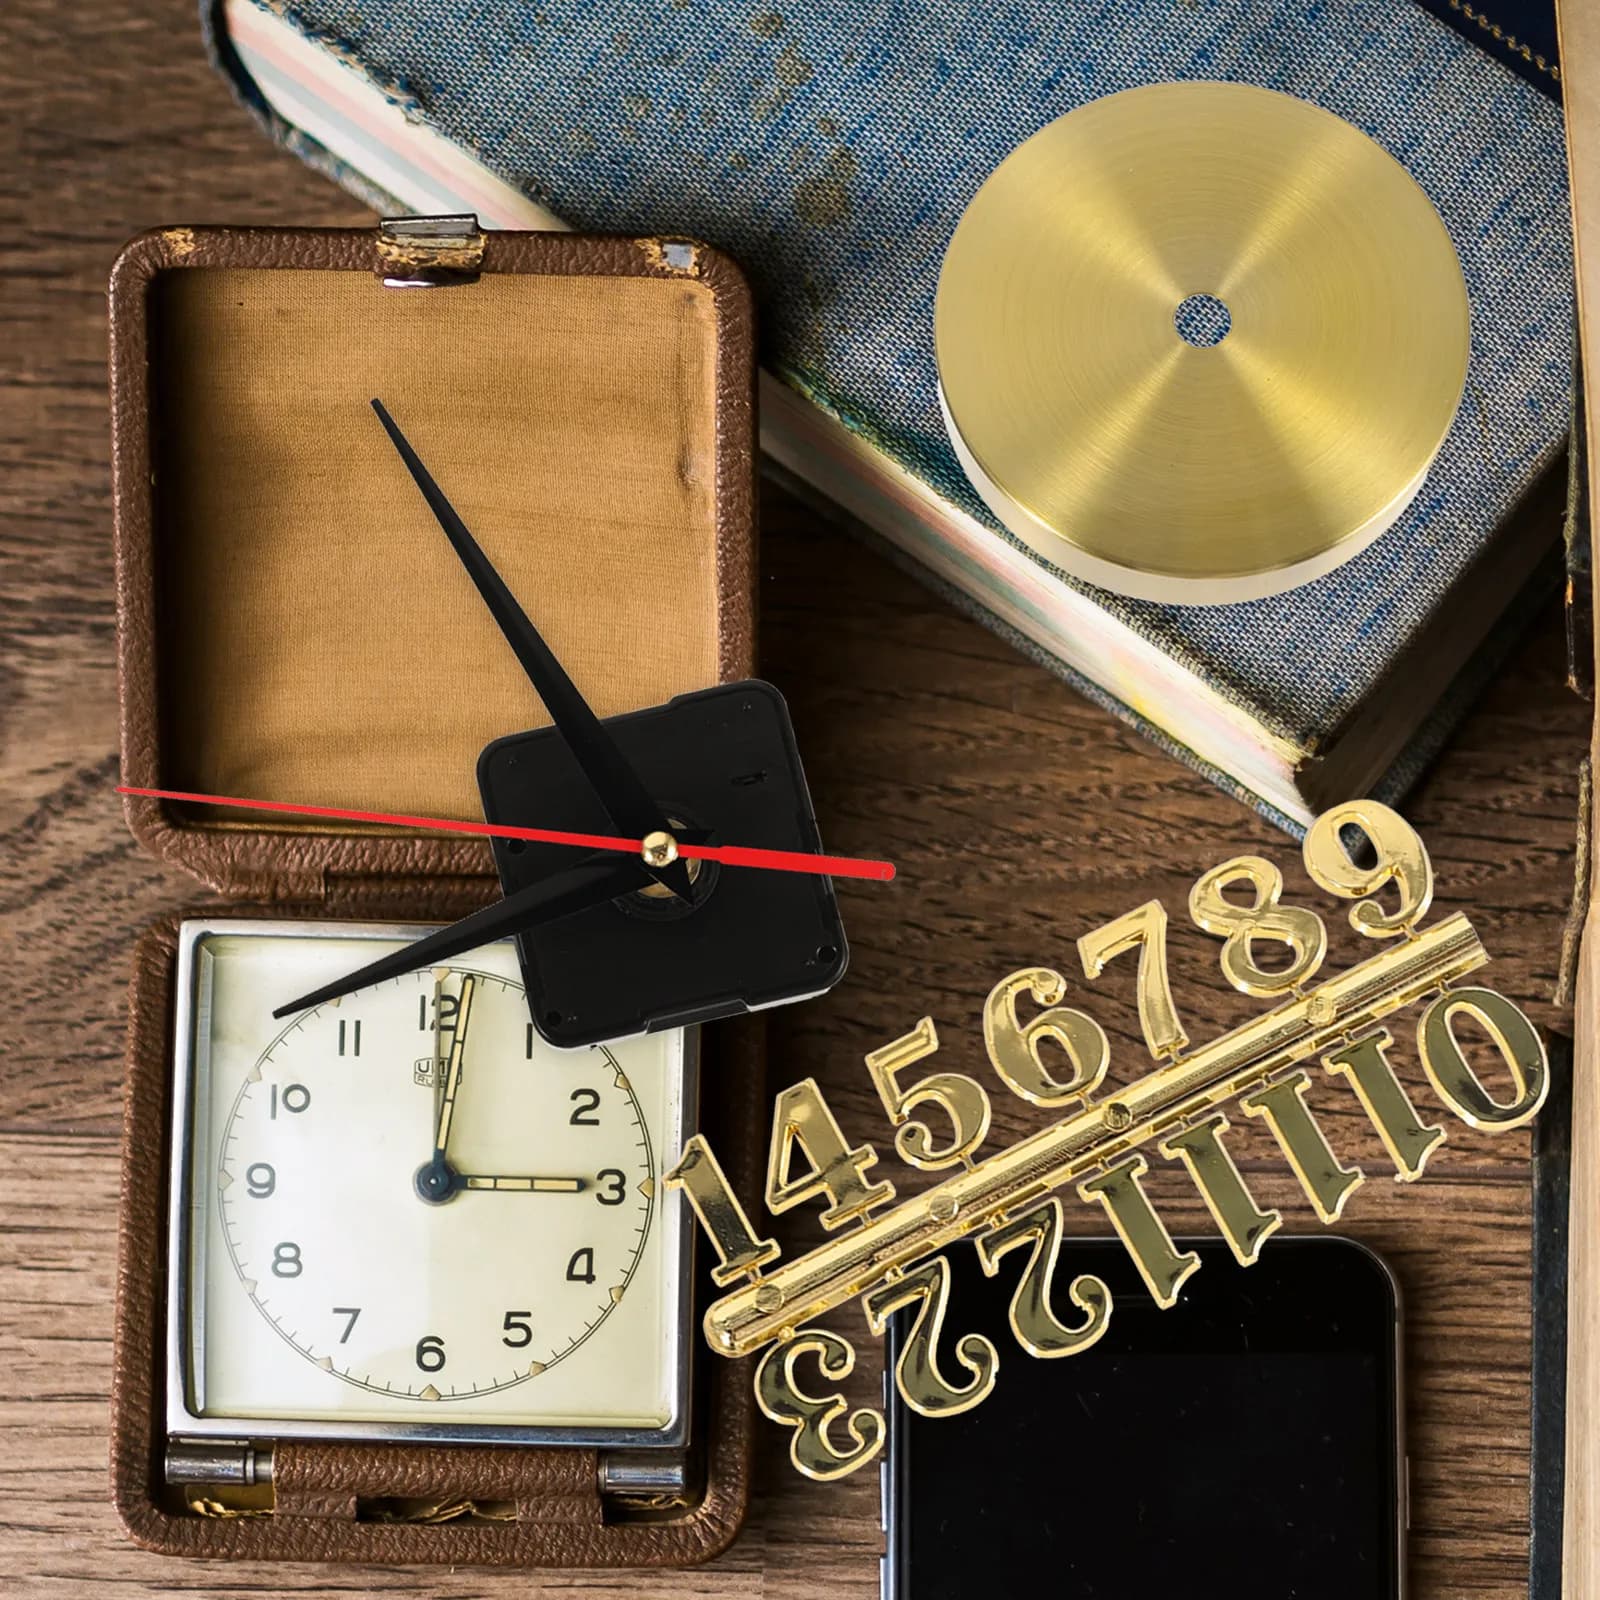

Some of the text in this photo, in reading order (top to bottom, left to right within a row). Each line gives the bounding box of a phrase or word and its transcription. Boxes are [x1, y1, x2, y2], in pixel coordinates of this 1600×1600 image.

[419, 994, 460, 1032] 12
[338, 1019, 362, 1057] 11
[525, 1022, 534, 1060] 1
[662, 799, 1434, 1287] 1 4 5 6 7 8 9
[269, 1083, 312, 1121] 10
[569, 1088, 600, 1126] 2
[245, 1162, 276, 1199] 9
[595, 1169, 627, 1206] 3
[271, 1241, 303, 1278] 8
[565, 1247, 597, 1285] 4
[332, 1307, 362, 1344] 7
[502, 1311, 533, 1348] 5
[415, 1336, 446, 1373] 6
